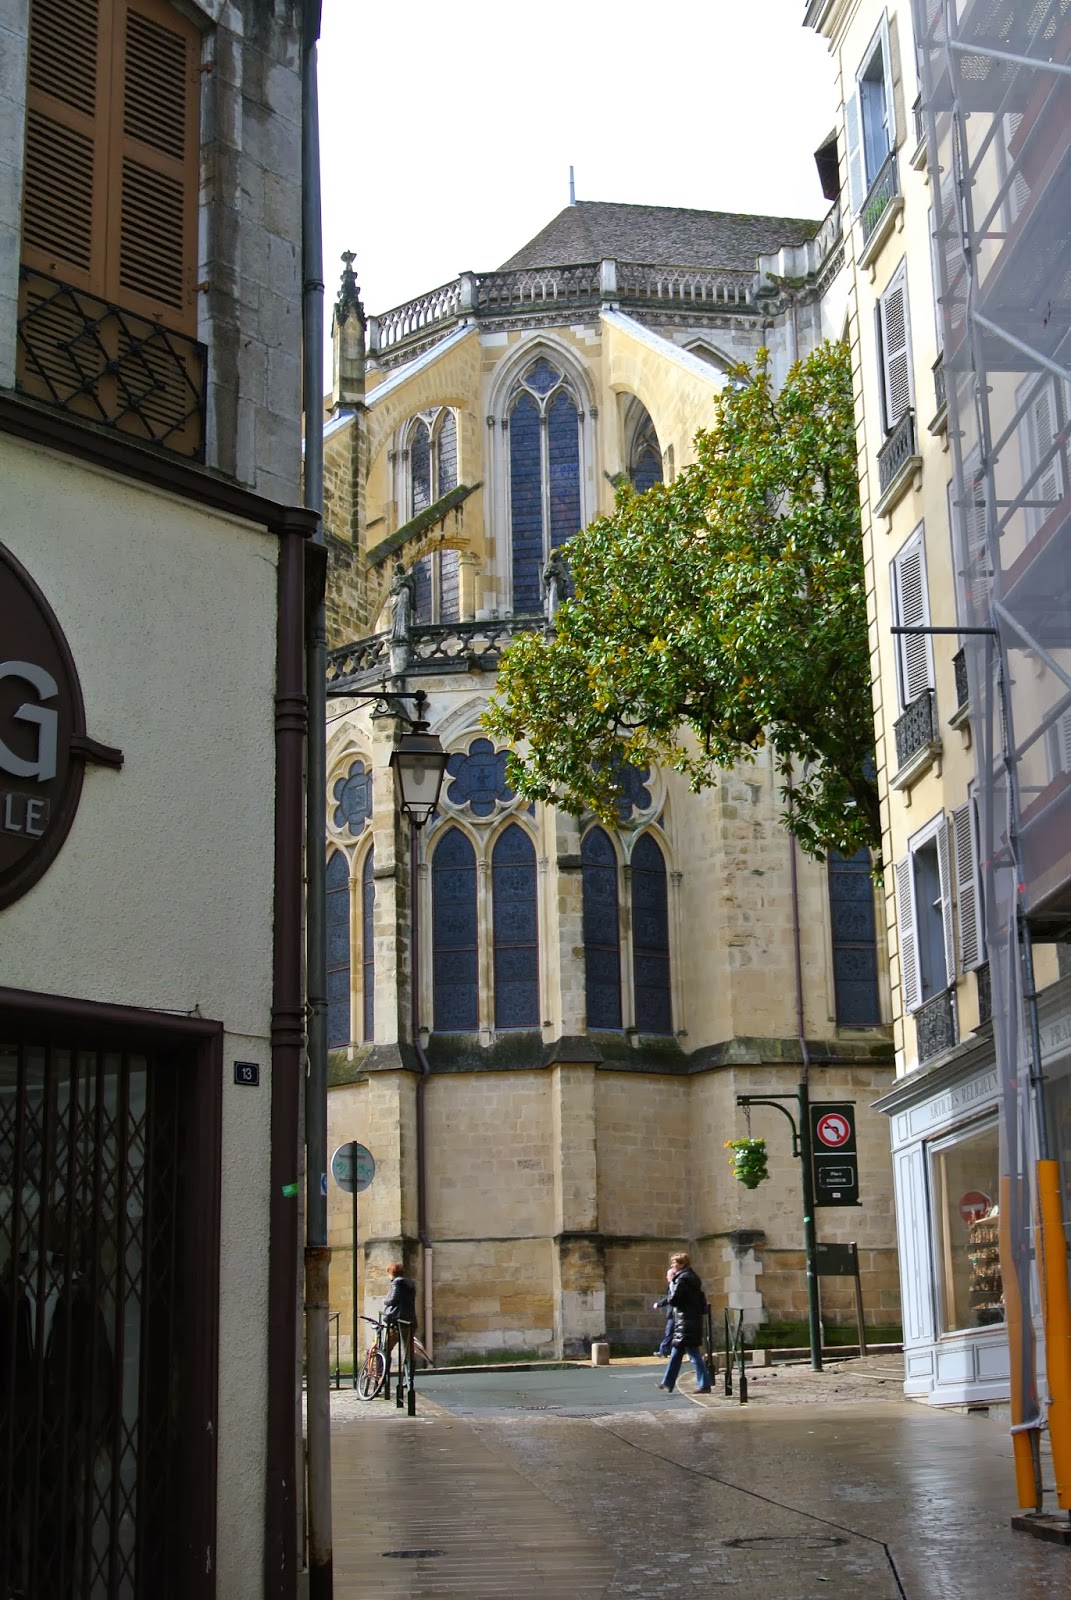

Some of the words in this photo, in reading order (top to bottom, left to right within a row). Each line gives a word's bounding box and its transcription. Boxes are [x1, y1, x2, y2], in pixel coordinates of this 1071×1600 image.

[0, 660, 58, 783] G
[5, 793, 45, 836] LE
[242, 1068, 252, 1080] 13
[929, 1094, 959, 1119] ARTICLES
